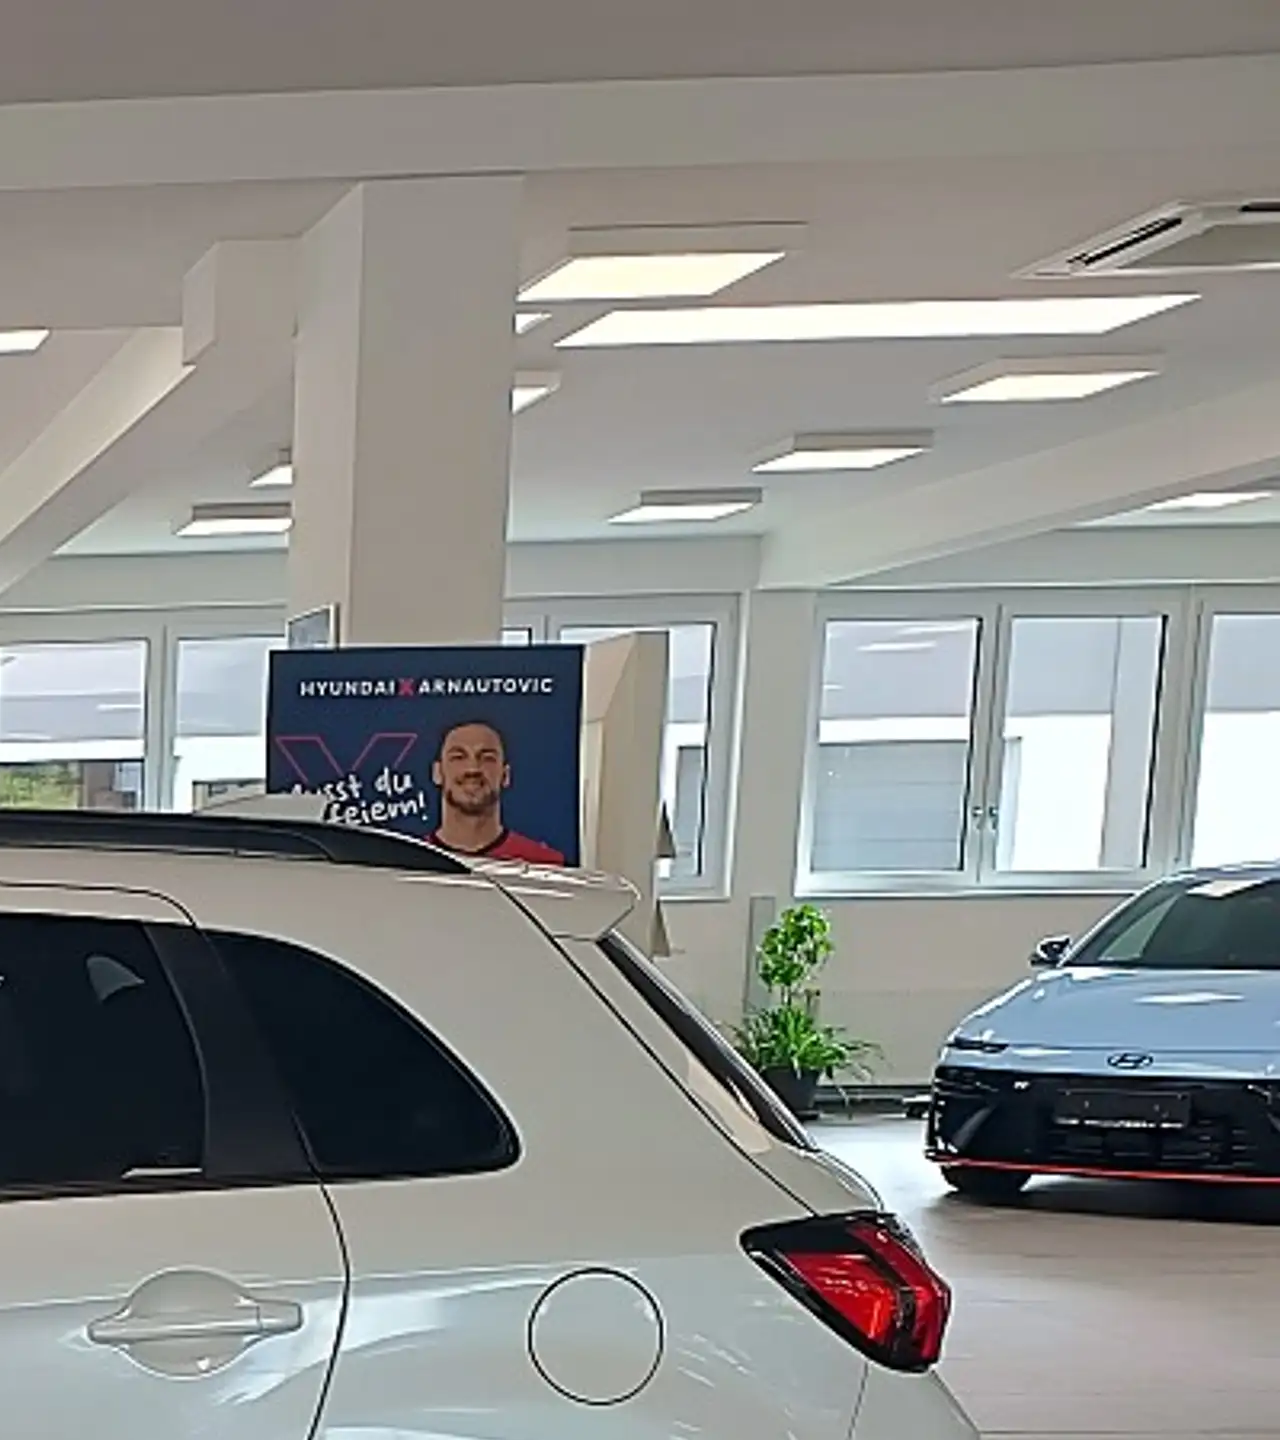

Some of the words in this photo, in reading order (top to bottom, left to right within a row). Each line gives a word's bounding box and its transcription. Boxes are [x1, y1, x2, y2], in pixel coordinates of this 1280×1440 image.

[300, 680, 395, 697] HYUNDAI
[417, 677, 554, 695] ARNAUTOVIC
[374, 765, 414, 797] du
